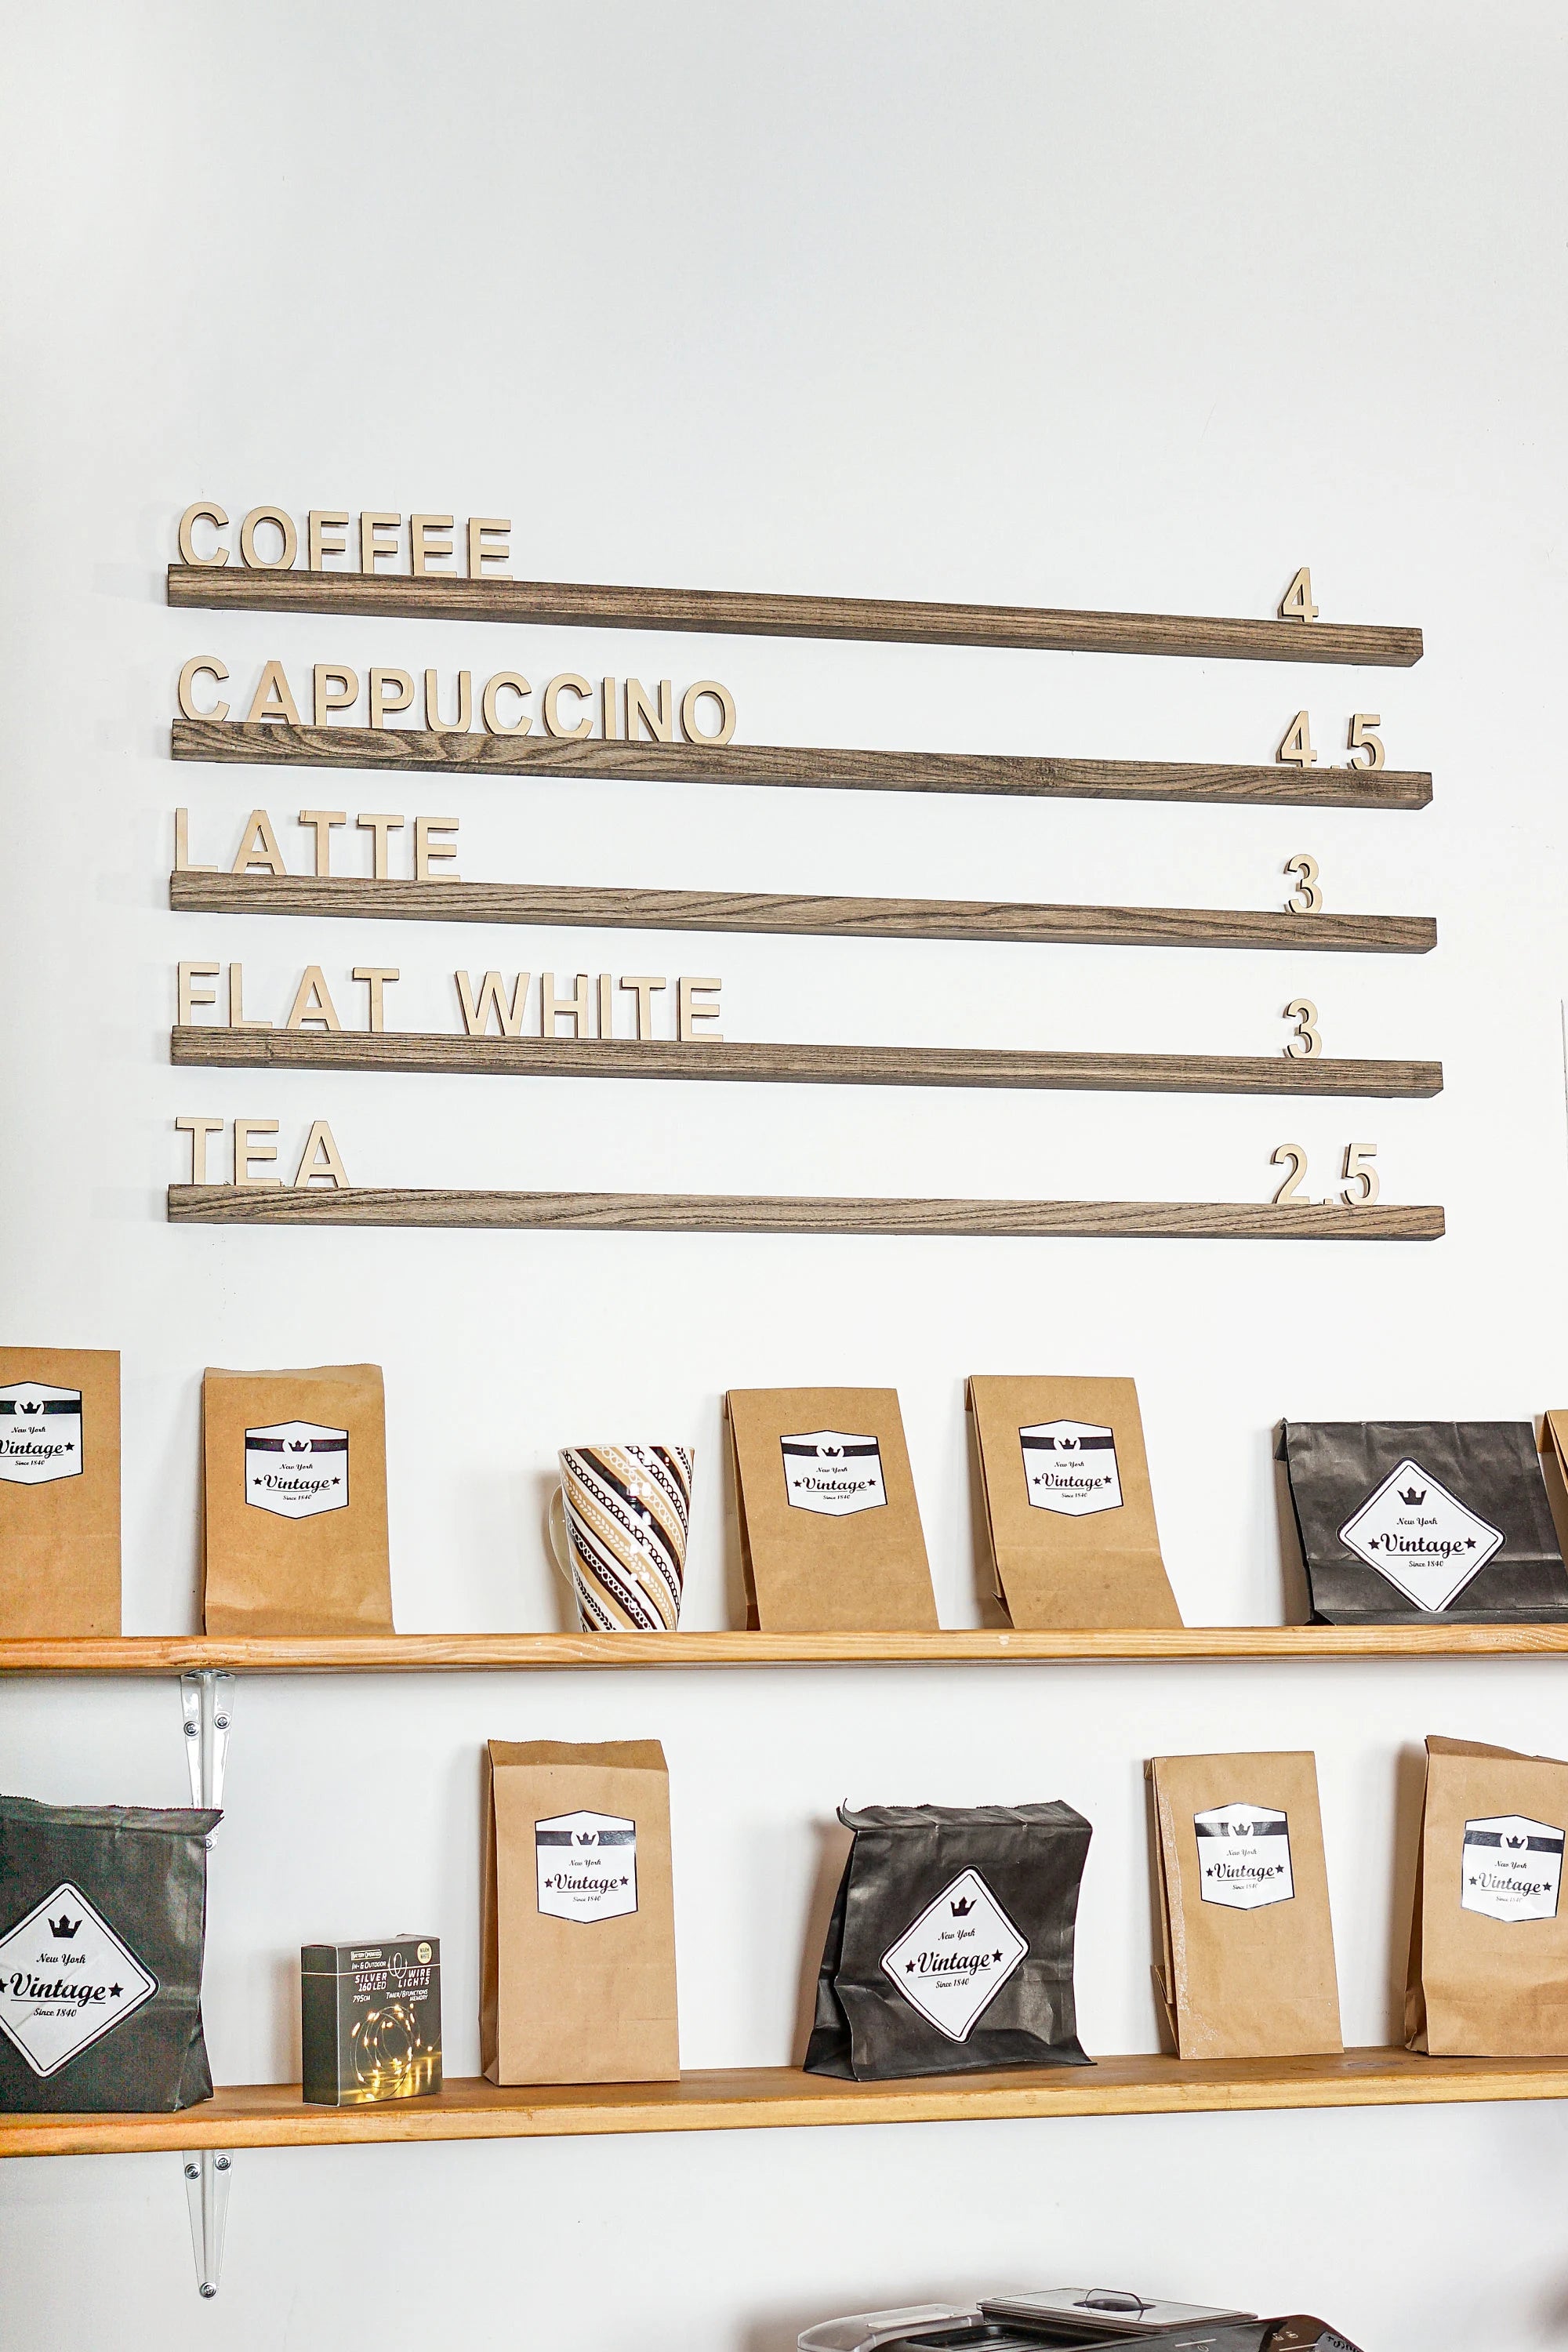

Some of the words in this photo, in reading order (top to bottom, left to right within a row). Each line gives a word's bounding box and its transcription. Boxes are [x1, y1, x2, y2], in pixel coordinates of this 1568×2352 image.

[179, 502, 514, 580] COFFEE
[1280, 567, 1319, 622] 4
[179, 655, 736, 745] CAPPUCCINO
[176, 808, 460, 882] LATTE
[1287, 854, 1323, 913] 3
[178, 961, 400, 1033] FLAT
[455, 971, 724, 1042] WHITE
[1287, 999, 1323, 1058] 3
[176, 1117, 350, 1188] TEA
[1273, 1143, 1380, 1205] 2.5
[0, 1439, 64, 1459] Vintage
[263, 1474, 330, 1494] Vintage
[802, 1477, 866, 1494] Vintage
[1041, 1472, 1103, 1491] Vintage
[1416, 1517, 1438, 1527] York
[1380, 1533, 1465, 1559] Vintage
[584, 1859, 601, 1867] York
[1214, 1863, 1275, 1882] Vintage
[554, 1873, 619, 1894] Vintage
[1479, 1872, 1541, 1896] Vintage
[938, 1931, 955, 1940] New
[956, 1929, 975, 1941] York
[36, 1953, 59, 1963] New
[61, 1953, 86, 1966] York
[917, 1951, 991, 1976] Vintage
[354, 1973, 387, 1984] SILVER
[408, 1968, 431, 1977] WIRE
[358, 1983, 373, 1991] 160
[373, 1981, 387, 1991] LED
[398, 1977, 430, 1987] LIGHTS
[953, 1978, 969, 1987] 1840
[10, 1973, 107, 2007] Vintage
[34, 2008, 54, 2016] Since
[56, 2009, 77, 2017] 1840
